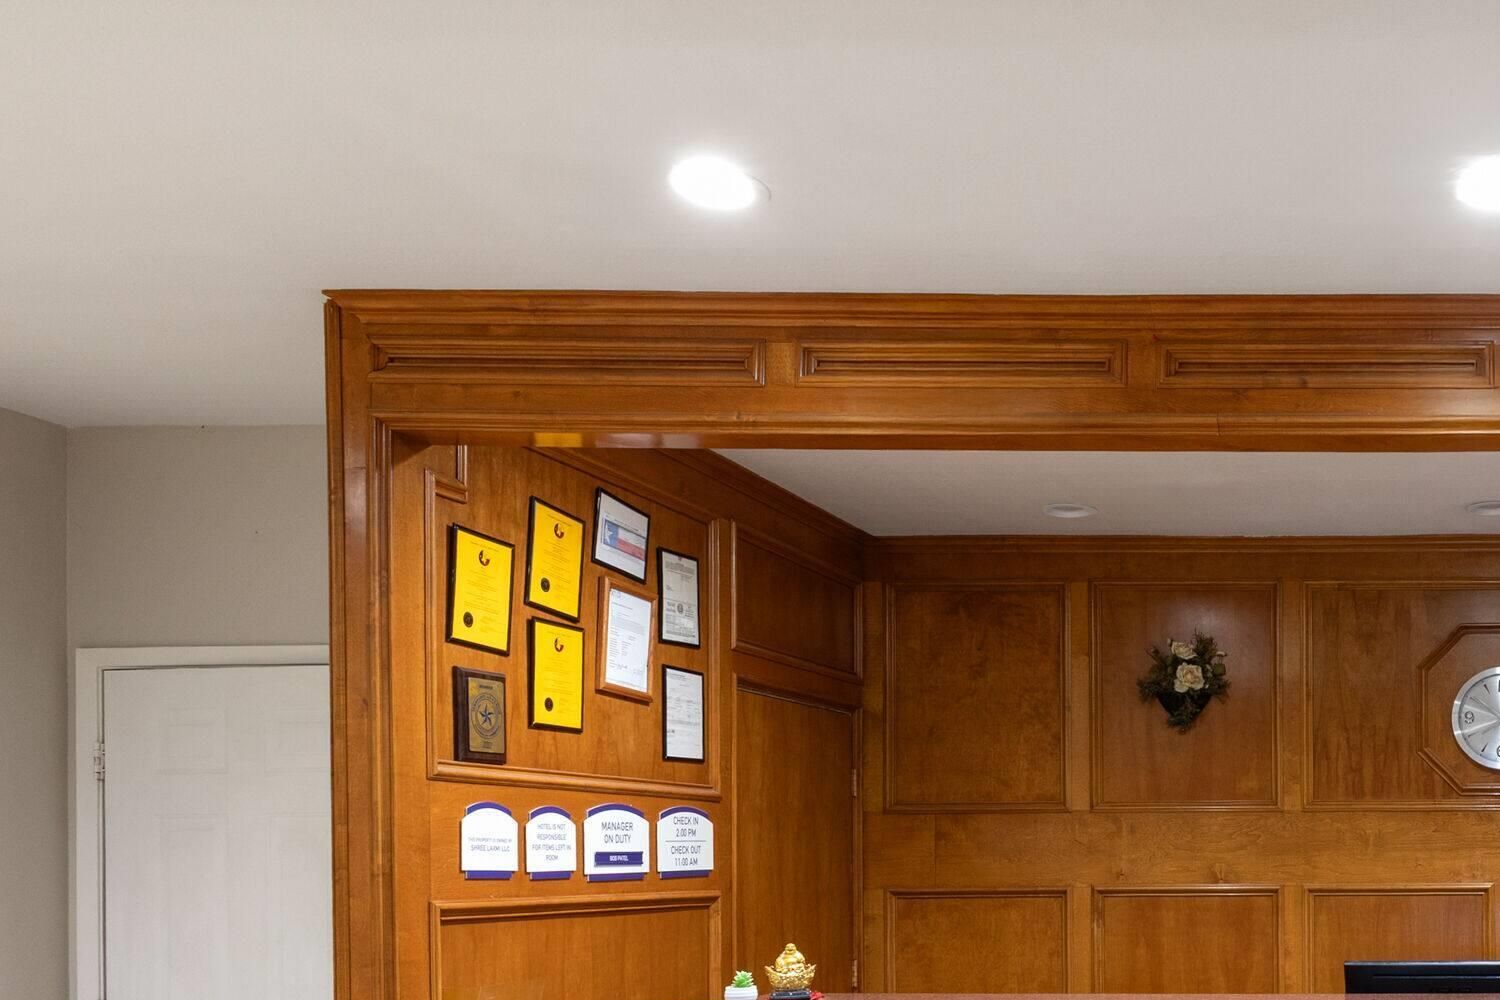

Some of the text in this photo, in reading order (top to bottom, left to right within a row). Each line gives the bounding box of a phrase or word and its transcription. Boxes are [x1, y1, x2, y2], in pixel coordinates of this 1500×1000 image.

[1464, 710, 1475, 724] 9
[673, 816, 699, 825] CHECK IN
[601, 821, 634, 831] MANAGER
[688, 828, 696, 837] PM
[604, 833, 631, 844] ON DUTY
[670, 845, 701, 855] CHECK OUT
[689, 857, 698, 866] AM
